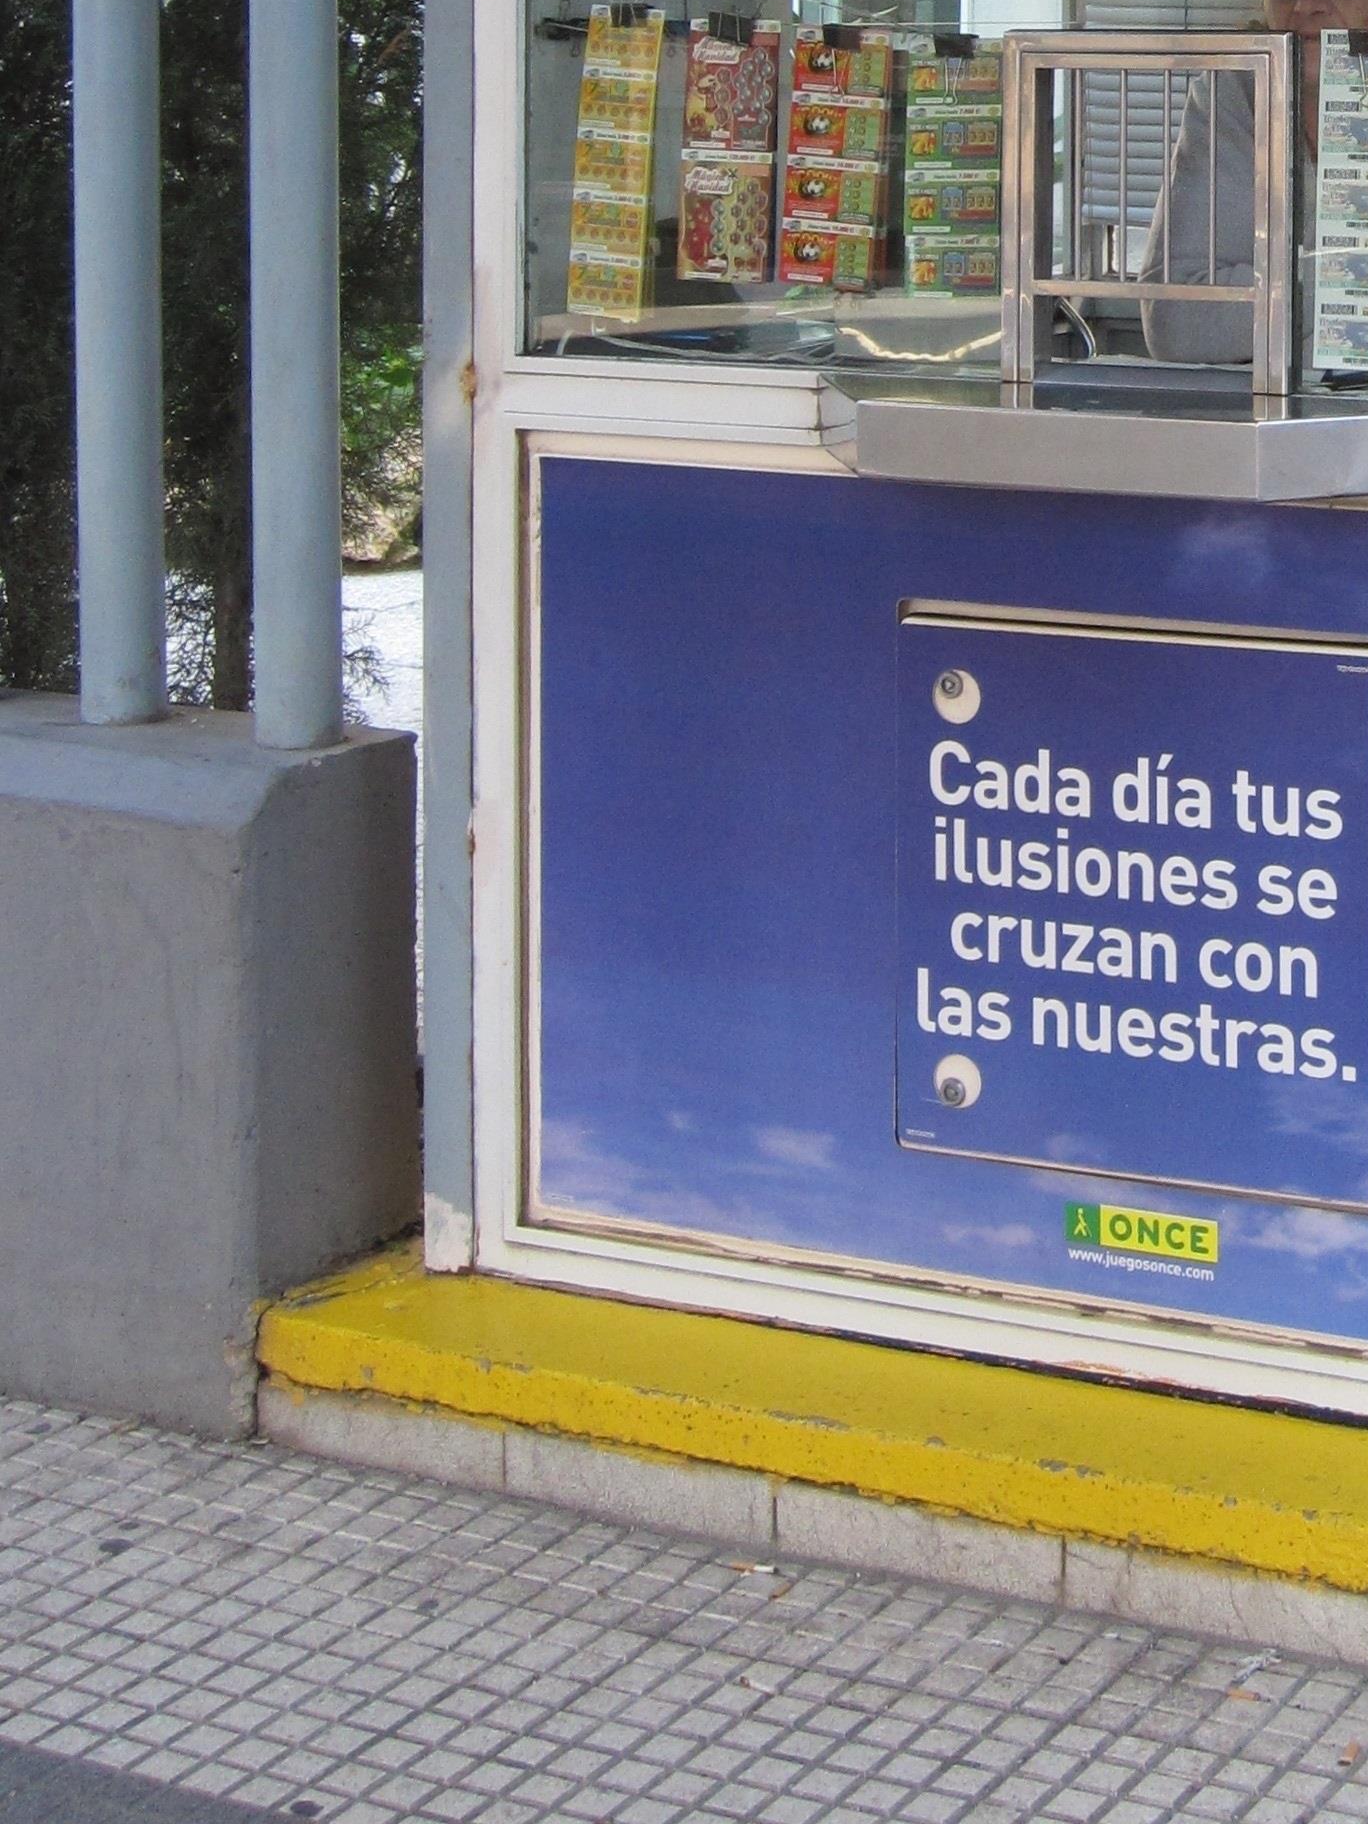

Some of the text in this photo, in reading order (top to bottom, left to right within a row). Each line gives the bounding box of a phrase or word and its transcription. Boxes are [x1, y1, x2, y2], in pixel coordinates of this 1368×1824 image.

[929, 739, 1344, 841] Cada día tus
[934, 816, 1338, 920] ilusiones se
[950, 912, 1318, 999] cruzan con
[917, 967, 1357, 1083] las nuestras.
[1068, 1247, 1215, 1281] www.juegosonce.com
[1109, 1214, 1209, 1254] ONCE
